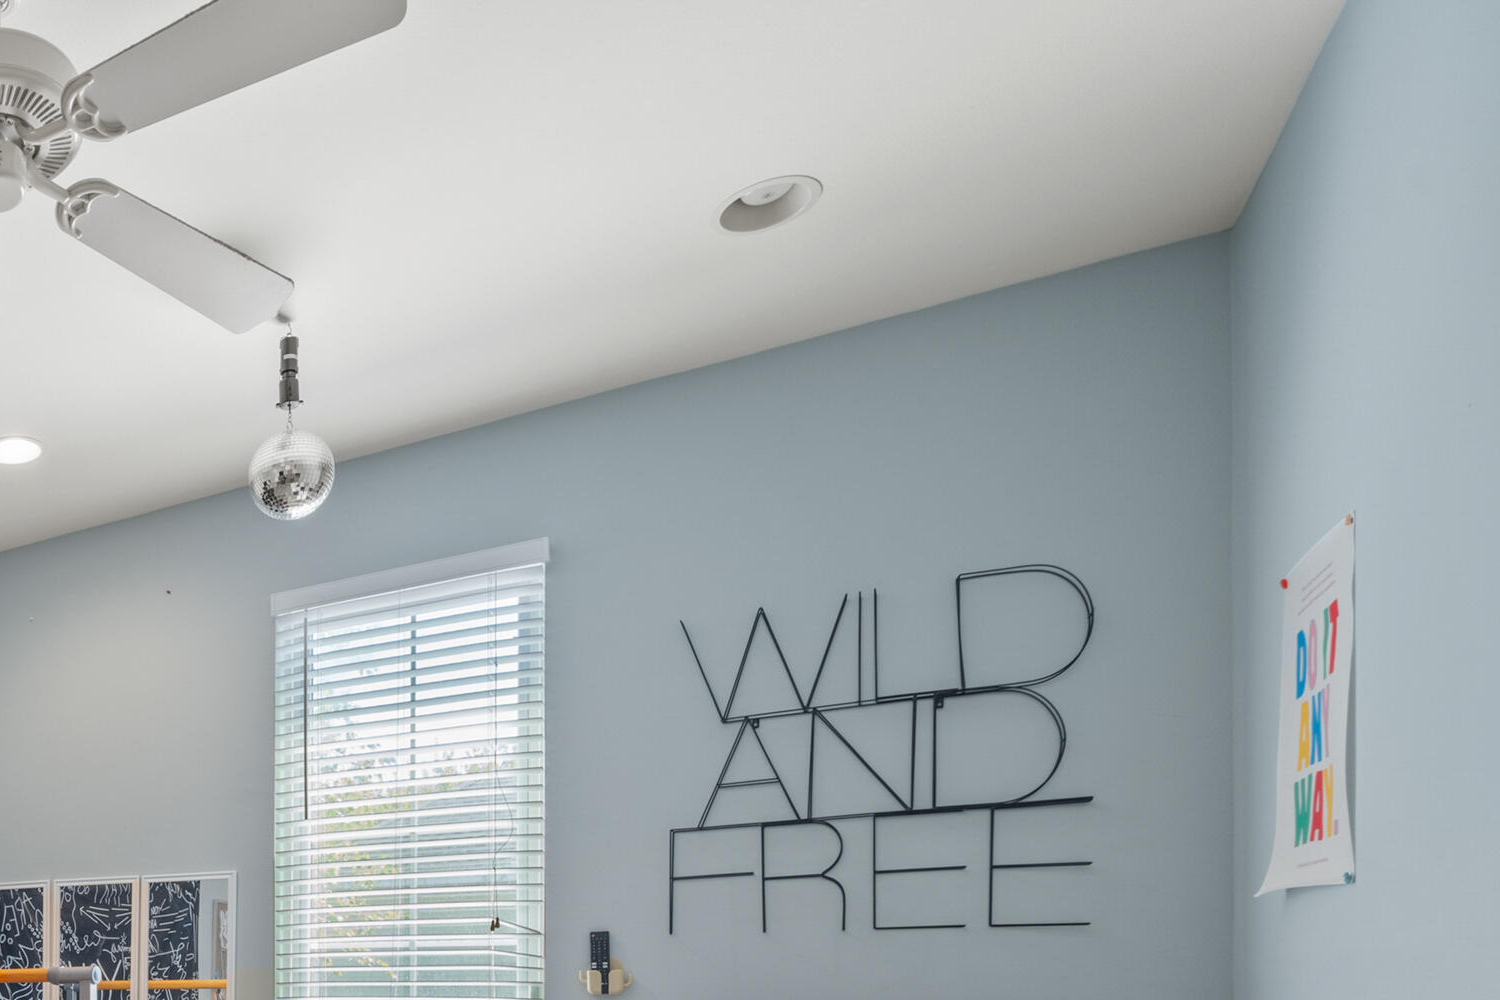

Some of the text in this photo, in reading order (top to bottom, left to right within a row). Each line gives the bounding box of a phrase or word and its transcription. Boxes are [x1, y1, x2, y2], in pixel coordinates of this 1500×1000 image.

[680, 564, 1094, 723] WILD
[1296, 598, 1339, 700] DO IT
[697, 685, 1067, 829] AND
[1297, 683, 1330, 772] ANY
[669, 795, 1093, 934] FREE
[1293, 763, 1339, 848] WAY.
